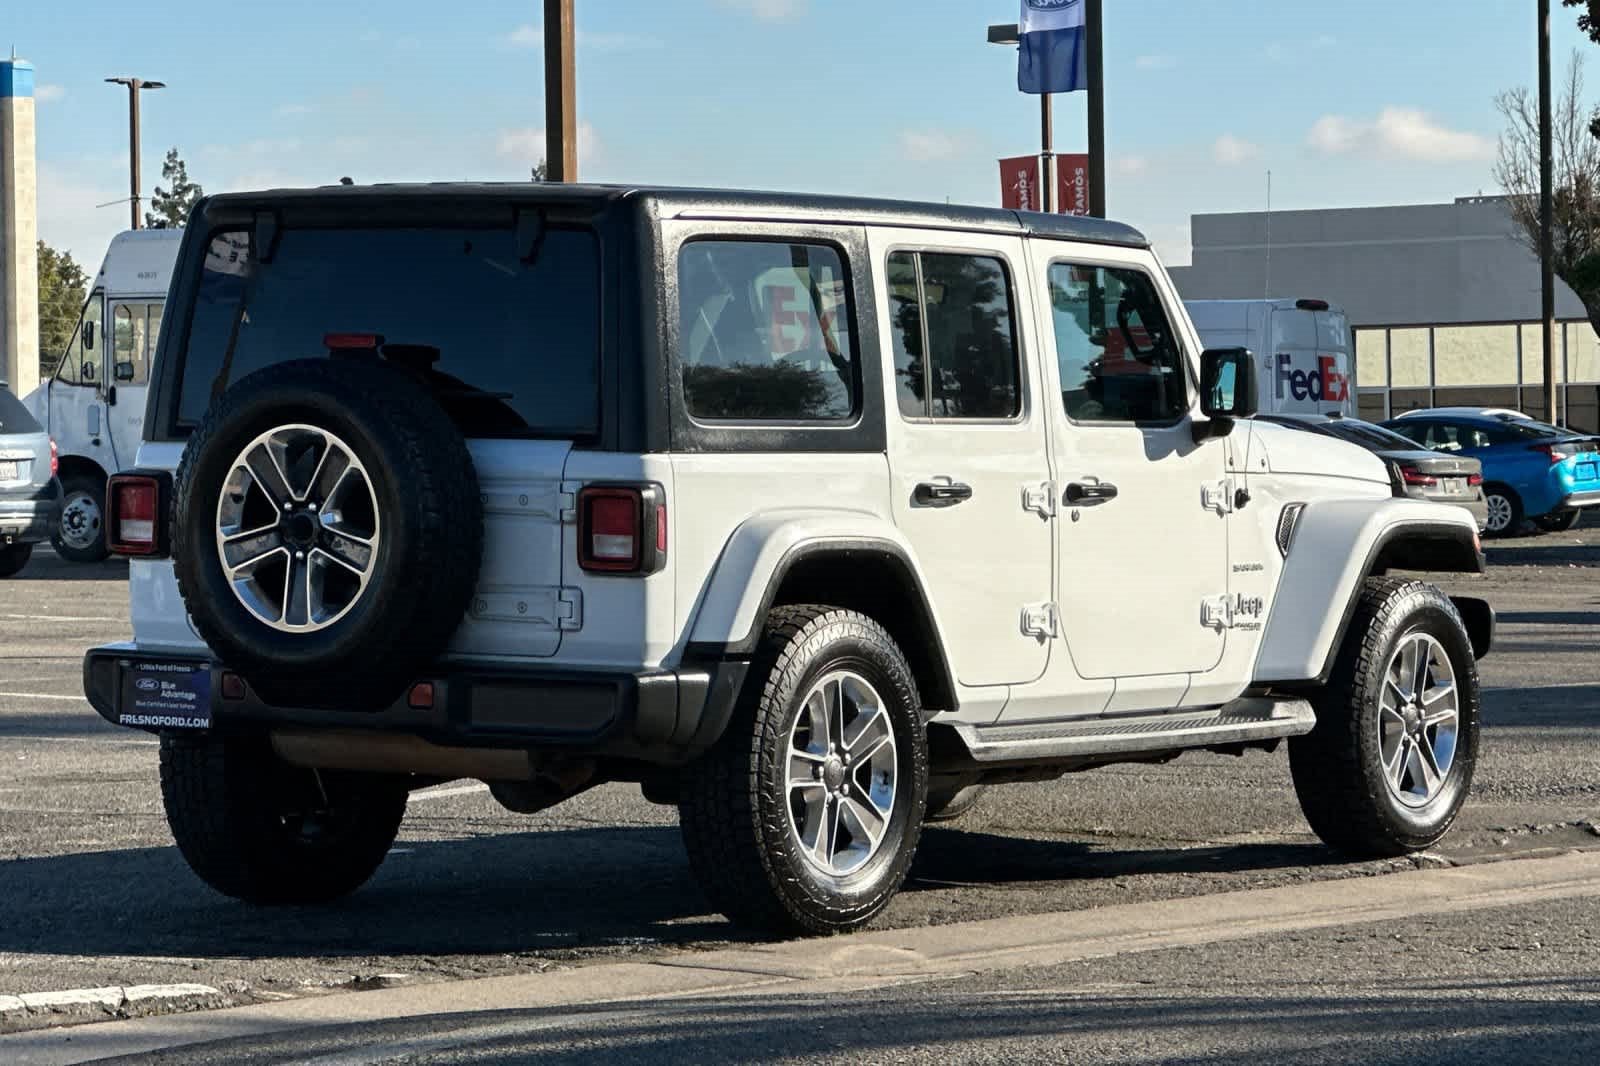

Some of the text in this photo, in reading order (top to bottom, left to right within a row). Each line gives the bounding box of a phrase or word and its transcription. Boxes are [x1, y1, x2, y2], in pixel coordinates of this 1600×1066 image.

[1275, 354, 1350, 402] FedEx
[1234, 593, 1263, 618] Jeep
[161, 681, 176, 689] Blue
[161, 690, 196, 700] Advantage
[120, 714, 209, 728] FRESNOFORD.COM
